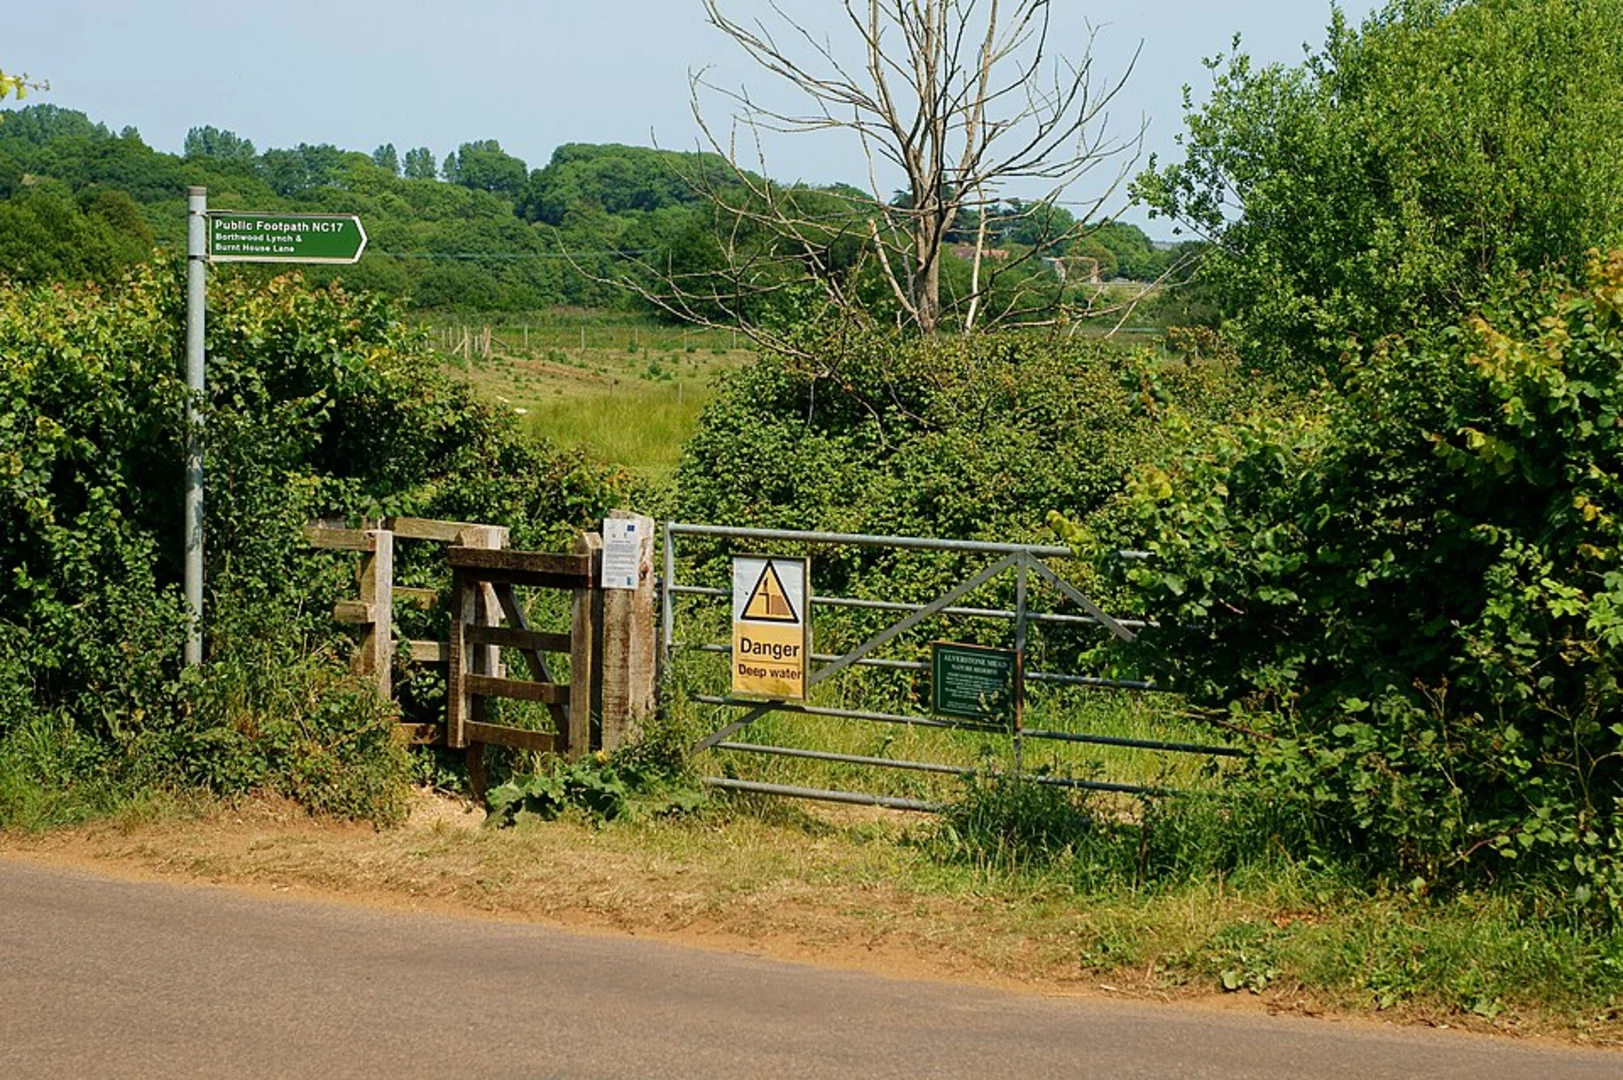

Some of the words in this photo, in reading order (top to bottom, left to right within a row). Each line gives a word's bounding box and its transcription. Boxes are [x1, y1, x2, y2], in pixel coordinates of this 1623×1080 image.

[215, 220, 253, 231] Public
[256, 221, 309, 233] Footpath
[312, 222, 344, 232] NC17
[215, 233, 264, 241] Borthwood
[266, 234, 293, 243] Lynch
[215, 243, 241, 251] Burnt
[242, 244, 271, 252] House
[273, 244, 295, 252] Lane
[740, 637, 800, 660] Danger
[944, 654, 986, 666] ALVERSTONE
[987, 659, 1008, 668] MEAD
[738, 663, 767, 679] Deep
[769, 668, 802, 680] water
